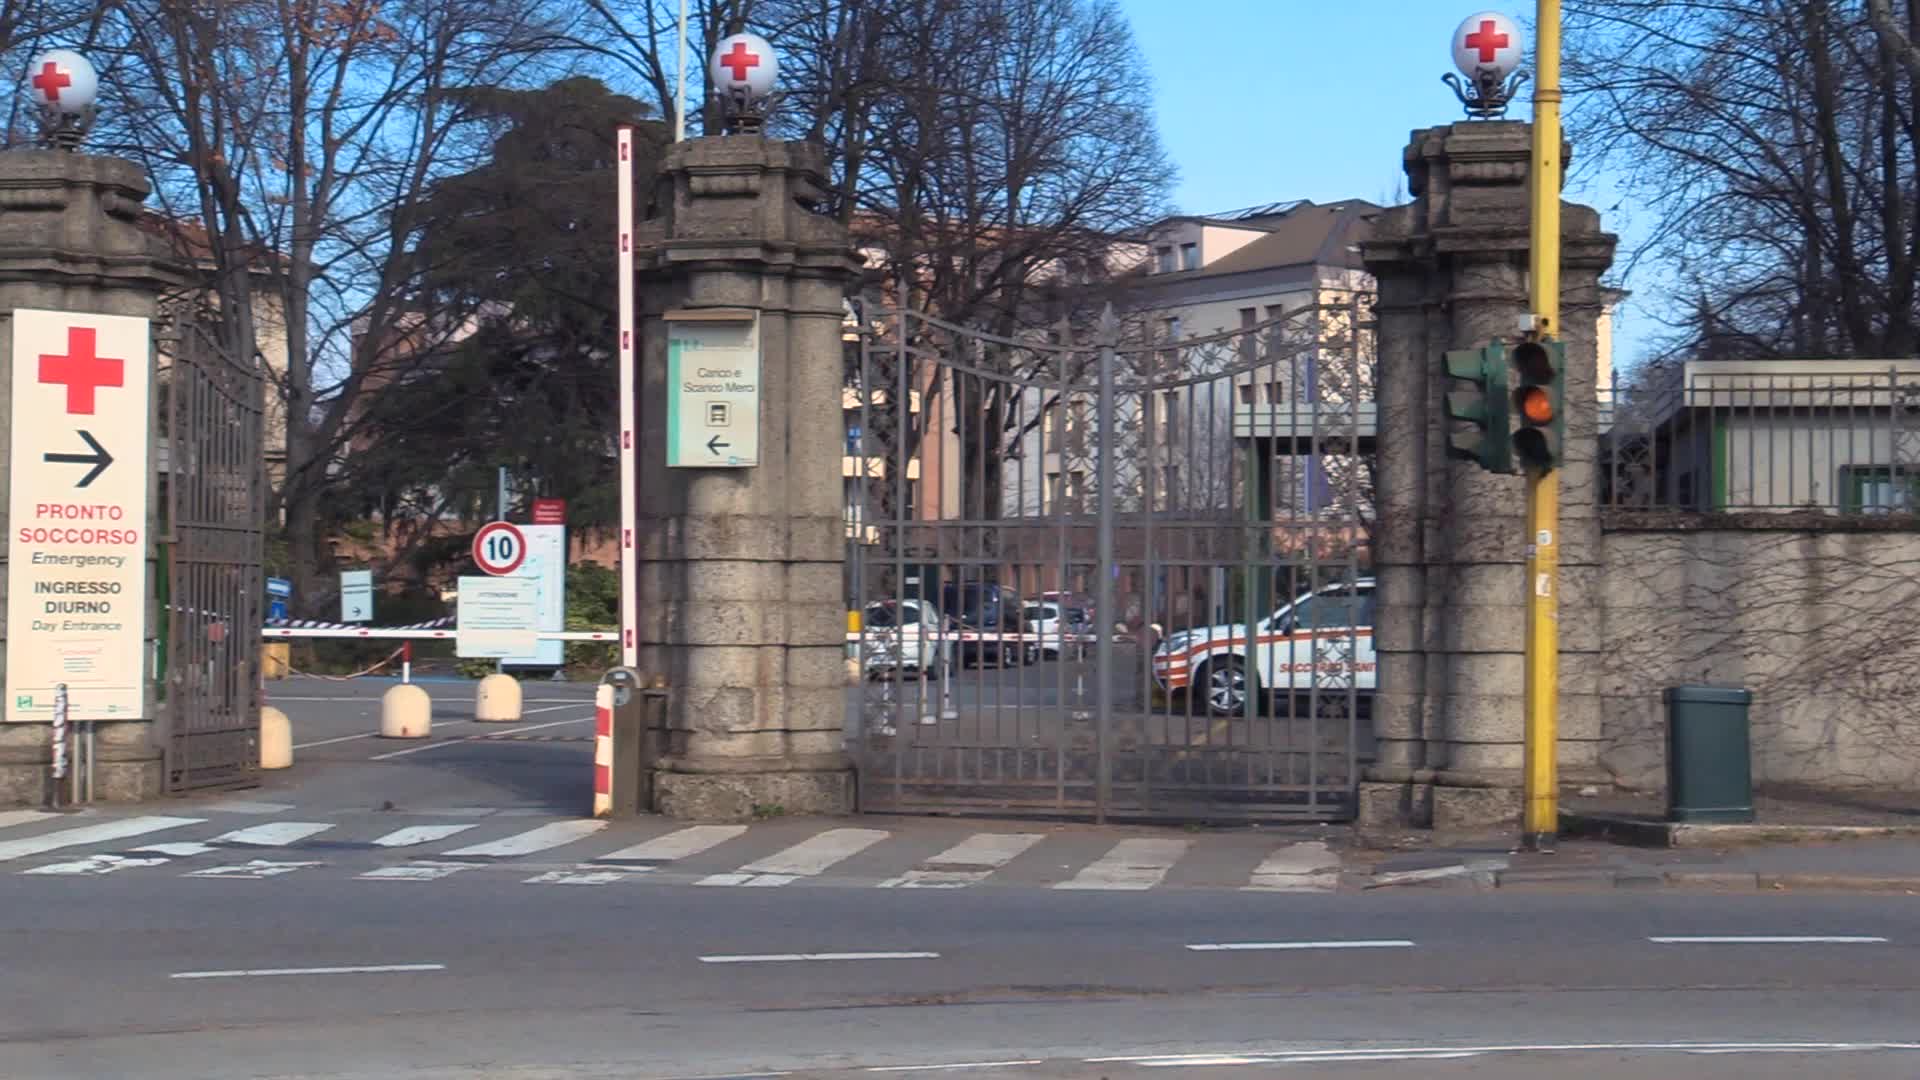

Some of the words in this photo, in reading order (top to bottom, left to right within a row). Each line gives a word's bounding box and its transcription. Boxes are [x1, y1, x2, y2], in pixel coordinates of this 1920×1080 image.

[36, 504, 122, 520] PRONTO
[19, 528, 138, 544] SOCCORSO
[487, 536, 512, 560] 10
[32, 552, 126, 568] Emergency
[34, 582, 121, 594] INGRESSO
[45, 601, 111, 613] DIURNO
[32, 620, 57, 632] Day
[62, 620, 122, 630] Entrance
